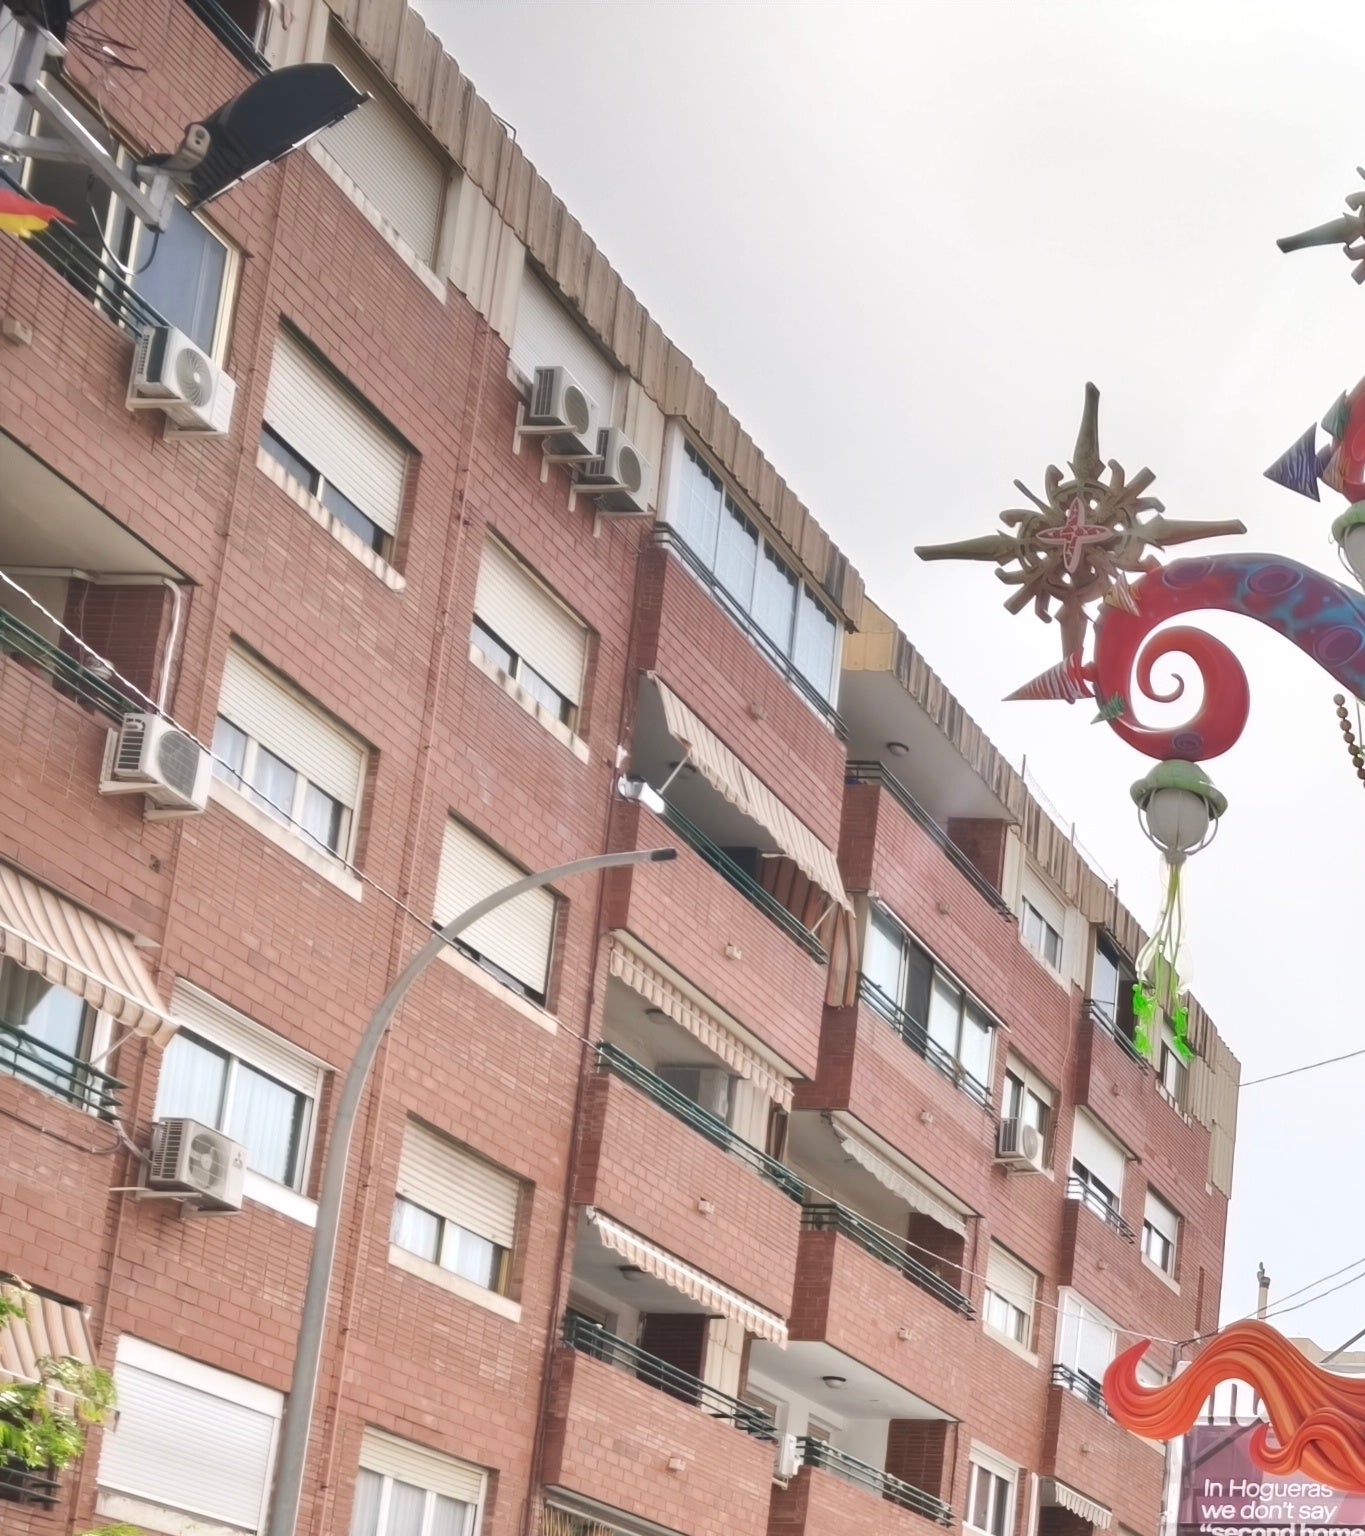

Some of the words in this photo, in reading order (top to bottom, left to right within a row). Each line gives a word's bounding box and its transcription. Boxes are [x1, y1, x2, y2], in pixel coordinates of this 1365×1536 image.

[1204, 1478, 1223, 1498] In
[1229, 1479, 1333, 1501] Hogueras
[1201, 1504, 1236, 1519] we
[1298, 1505, 1338, 1524] say
